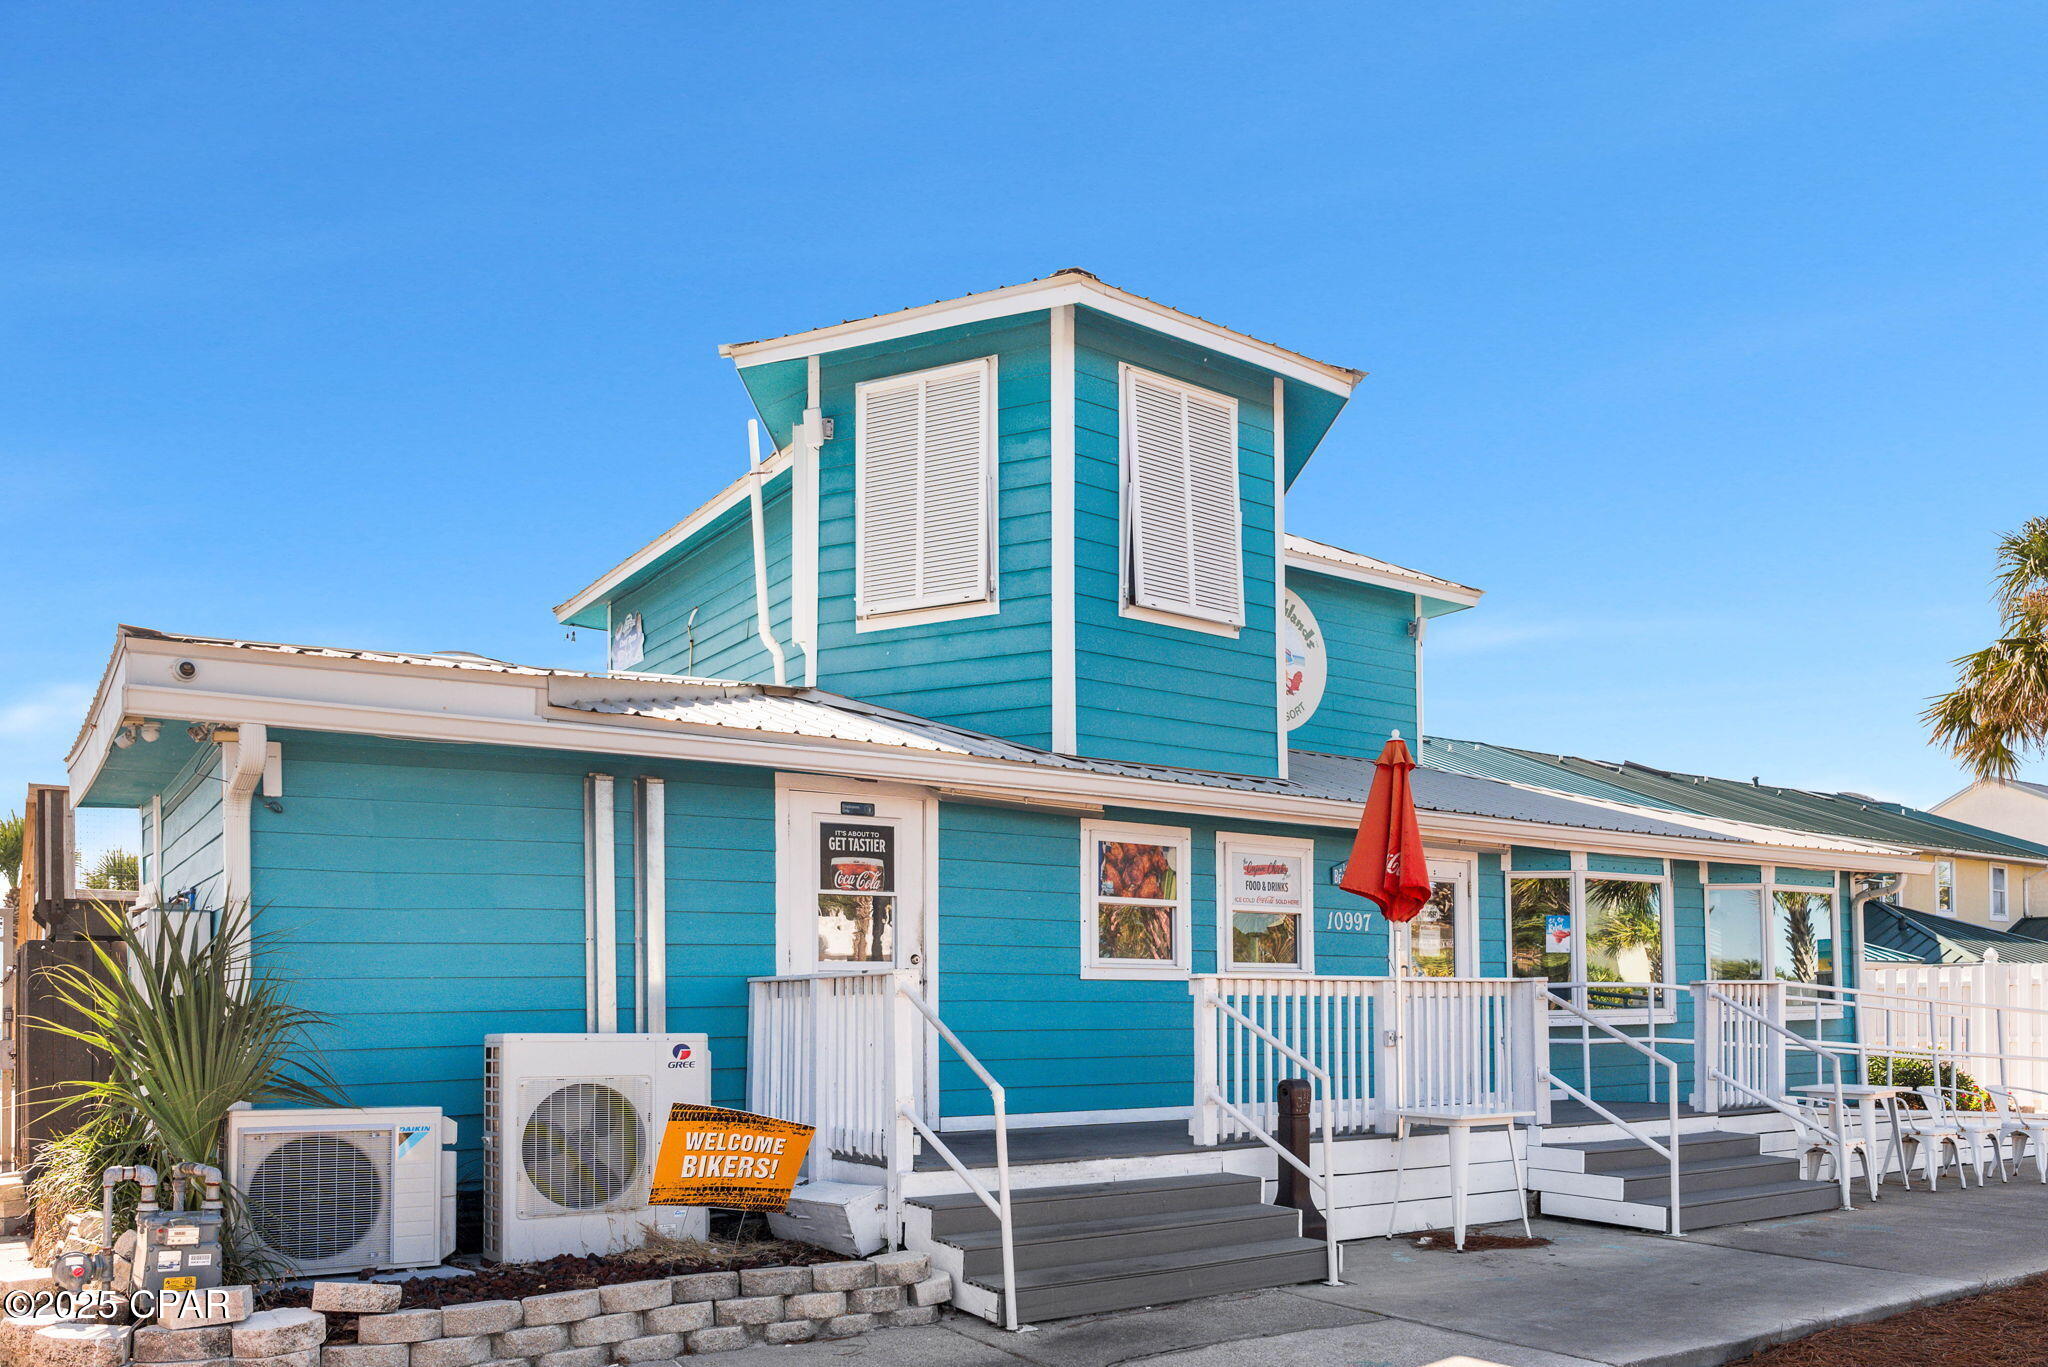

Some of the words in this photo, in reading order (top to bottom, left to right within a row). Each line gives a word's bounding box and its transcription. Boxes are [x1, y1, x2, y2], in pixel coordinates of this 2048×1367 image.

[828, 837, 846, 851] GET
[849, 838, 886, 853] TASTIER
[1245, 880, 1261, 891] FOOD
[1262, 881, 1267, 892] &
[1267, 881, 1289, 893] DRINKS
[1326, 911, 1372, 932] 10997
[667, 1060, 696, 1069] GREE
[685, 1131, 788, 1156] WELCOME
[680, 1155, 781, 1180] BIKERS!
